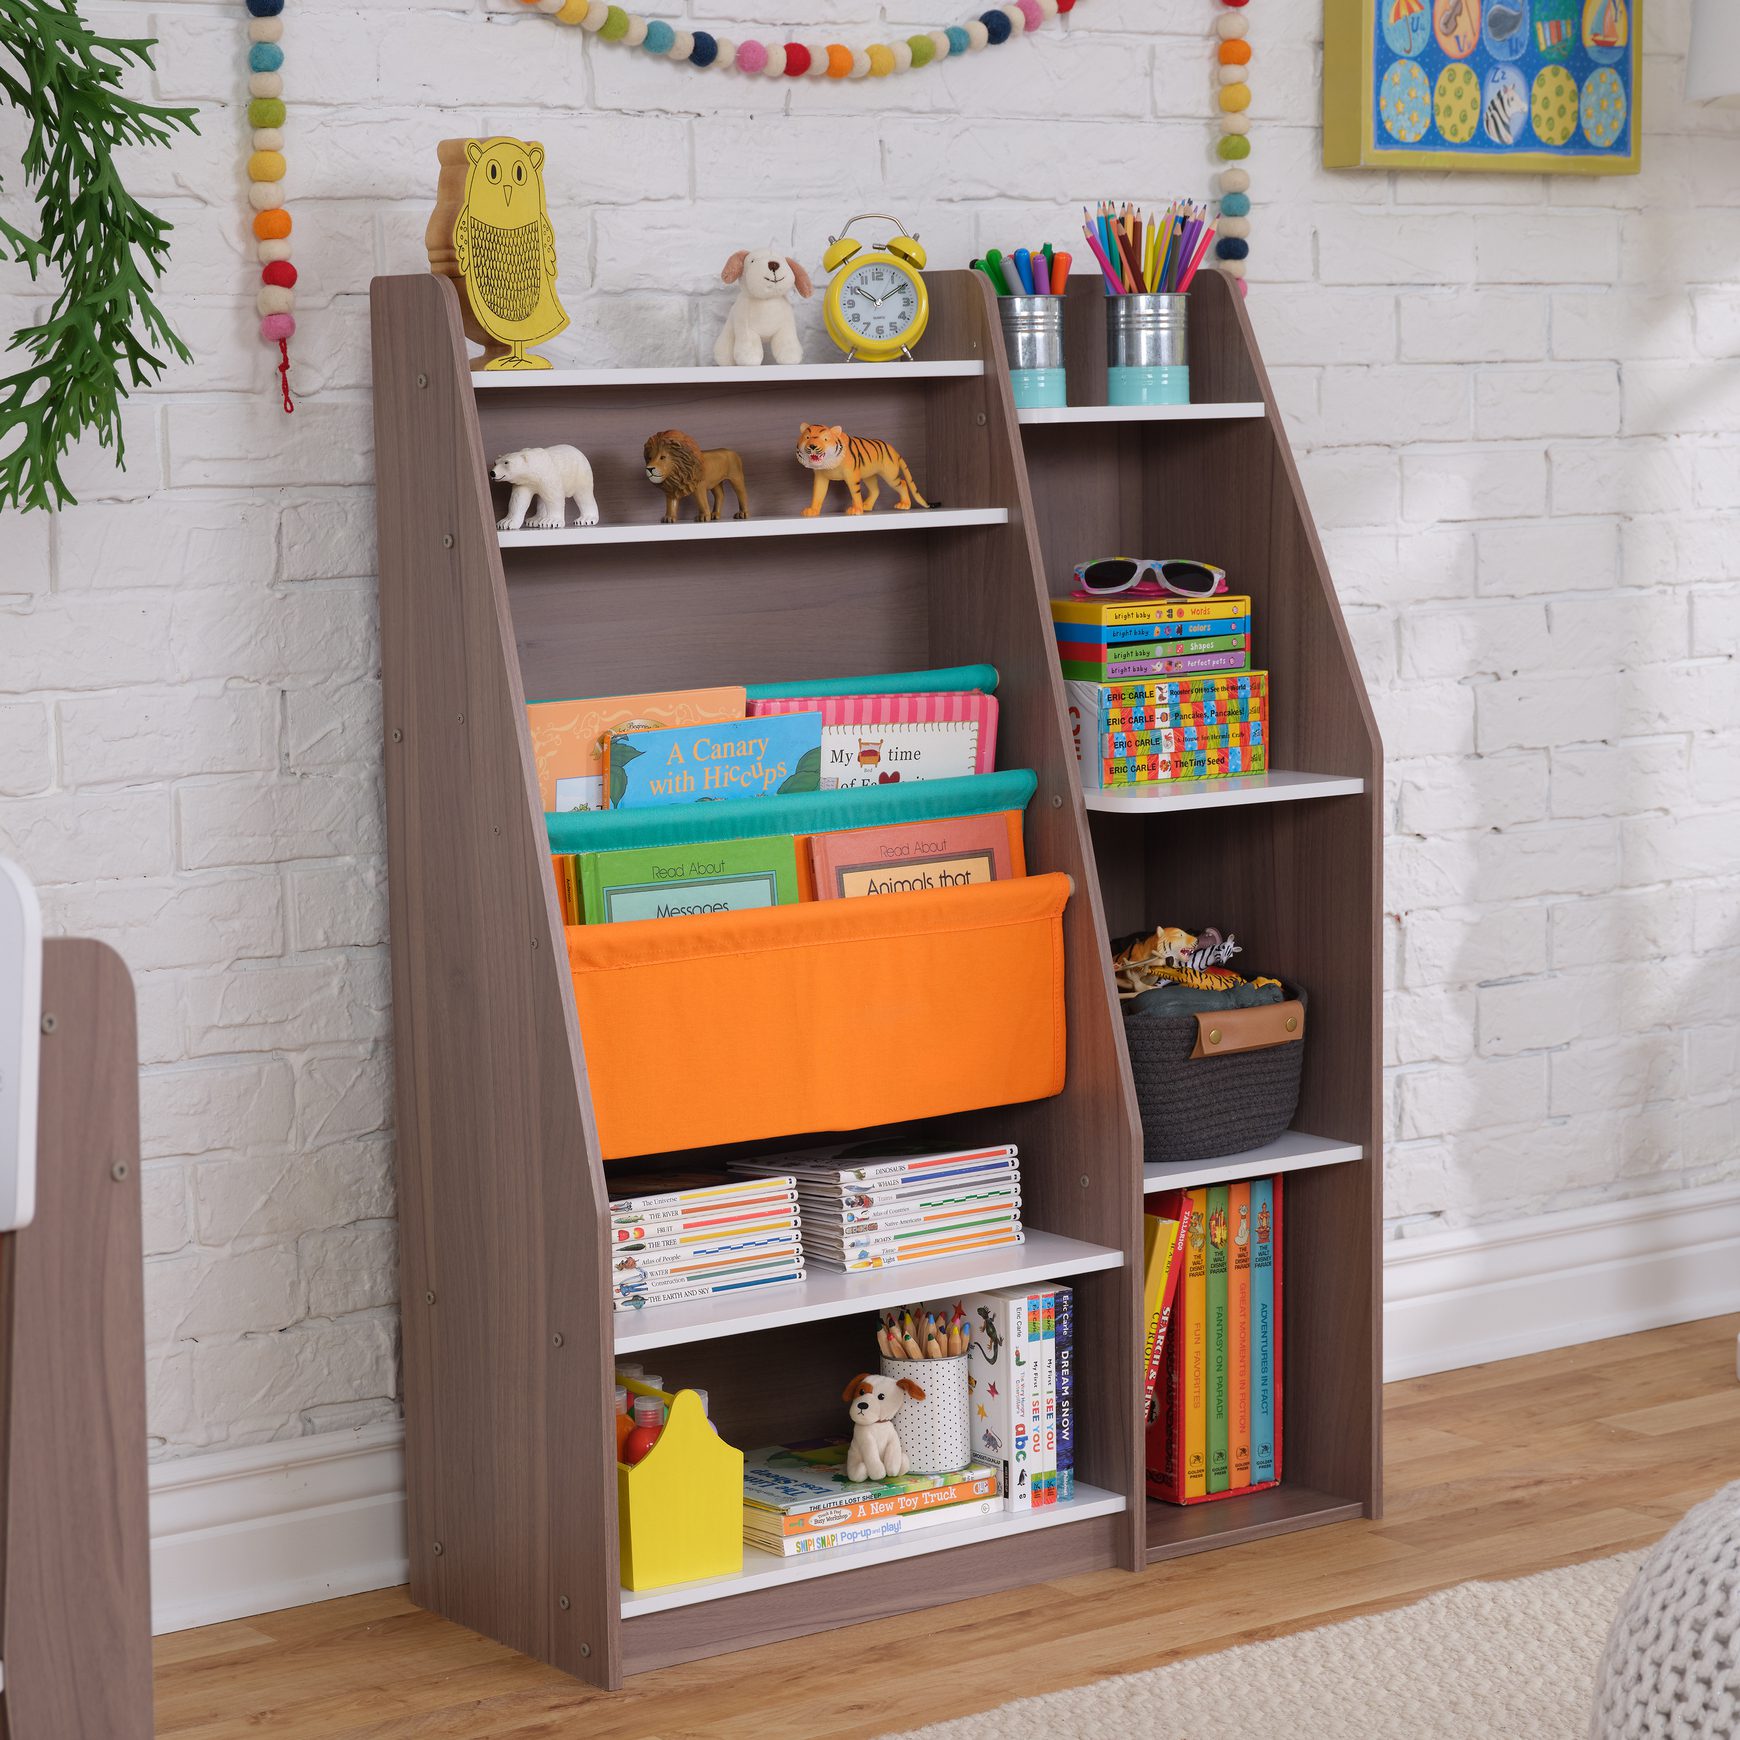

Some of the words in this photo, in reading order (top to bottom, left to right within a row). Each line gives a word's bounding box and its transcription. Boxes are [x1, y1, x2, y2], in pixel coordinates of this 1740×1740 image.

[860, 275, 868, 285] 11
[872, 272, 884, 281] 12
[891, 275, 895, 284] 1
[846, 300, 856, 309] 9
[902, 297, 911, 307] 3
[852, 313, 861, 322] 8
[898, 311, 907, 321] 4
[862, 322, 871, 332] 7
[876, 326, 884, 334] 6
[889, 322, 898, 331] 5
[1114, 612, 1134, 620] bright
[1136, 611, 1151, 619] baby
[1112, 629, 1133, 638] bright
[1134, 628, 1149, 637] baby
[1190, 641, 1214, 651] Shapes
[1114, 650, 1134, 659] bright
[1135, 649, 1151, 658] baby
[1187, 659, 1211, 667] Perfect
[1211, 657, 1226, 667] pets
[1111, 666, 1131, 675] bright
[1132, 665, 1148, 674] baby
[1107, 692, 1126, 701] ERIC
[1128, 690, 1155, 699] CARLE
[1174, 712, 1210, 721] Pancakes,
[1210, 708, 1245, 717] Pancakes!
[1107, 717, 1126, 726] ERIC
[1127, 715, 1154, 724] CARLE
[1113, 740, 1133, 749] ERIC
[1134, 737, 1161, 746] CARLE
[666, 742, 685, 765] A
[693, 738, 769, 761] Canary
[830, 749, 854, 766] My
[888, 747, 922, 762] time
[1174, 760, 1189, 768] The
[1189, 759, 1206, 767] Tiny
[1206, 757, 1225, 765] Seed
[1109, 765, 1128, 775] ERIC
[1130, 763, 1157, 772] CARLE
[649, 770, 695, 796] with
[703, 761, 787, 790] Hiccups
[880, 844, 911, 858] Read
[914, 839, 948, 854] About
[652, 863, 685, 880] Read
[688, 859, 726, 875] About
[867, 872, 934, 897] Animals
[938, 870, 972, 887] that
[875, 1166, 906, 1175] DINOSAURS
[877, 1178, 900, 1188] WHALES
[653, 1196, 678, 1205] Universe
[649, 1212, 661, 1220] THE
[889, 1207, 910, 1215] Countries
[884, 1220, 899, 1228] Native
[899, 1217, 922, 1226] Americans
[656, 1226, 673, 1234] FRUIT
[1177, 1211, 1190, 1251] TALLARICO
[648, 1241, 660, 1249] THE
[661, 1238, 678, 1247] TREE
[641, 1258, 655, 1266] Atlas
[655, 1256, 662, 1264] of
[662, 1254, 681, 1262] People
[882, 1256, 896, 1265] Light
[649, 1269, 669, 1277] WATER
[651, 1277, 686, 1287] Construction
[648, 1295, 661, 1303] THE
[662, 1292, 683, 1301] EARTH
[683, 1289, 697, 1297] AND
[697, 1287, 710, 1295] SKY
[1152, 1306, 1171, 1366] SEARCH
[1260, 1303, 1268, 1374] ADVENTURES
[1032, 1361, 1038, 1371] My
[1047, 1359, 1052, 1368] My
[1216, 1355, 1223, 1372] ON
[1061, 1351, 1069, 1396] DREAM
[1149, 1369, 1157, 1380] &
[1240, 1382, 1247, 1390] IN
[1261, 1377, 1268, 1387] IN
[1032, 1400, 1040, 1422] SEE
[1061, 1400, 1070, 1440] SNOW
[1015, 1423, 1028, 1463] abc
[809, 1504, 822, 1512] THE
[822, 1500, 843, 1508] LITTLE
[844, 1497, 860, 1505] LOST
[861, 1493, 882, 1502] SHEEP
[857, 1505, 867, 1517] A
[870, 1502, 895, 1515] New
[898, 1497, 919, 1510] Toy
[922, 1486, 957, 1505] Truck
[813, 1517, 825, 1525] Busy
[825, 1514, 849, 1522] Workshop
[796, 1537, 815, 1553] SNIP!
[816, 1533, 839, 1549] SNAP!
[840, 1527, 872, 1541] Pop-up
[881, 1519, 902, 1537] play!
